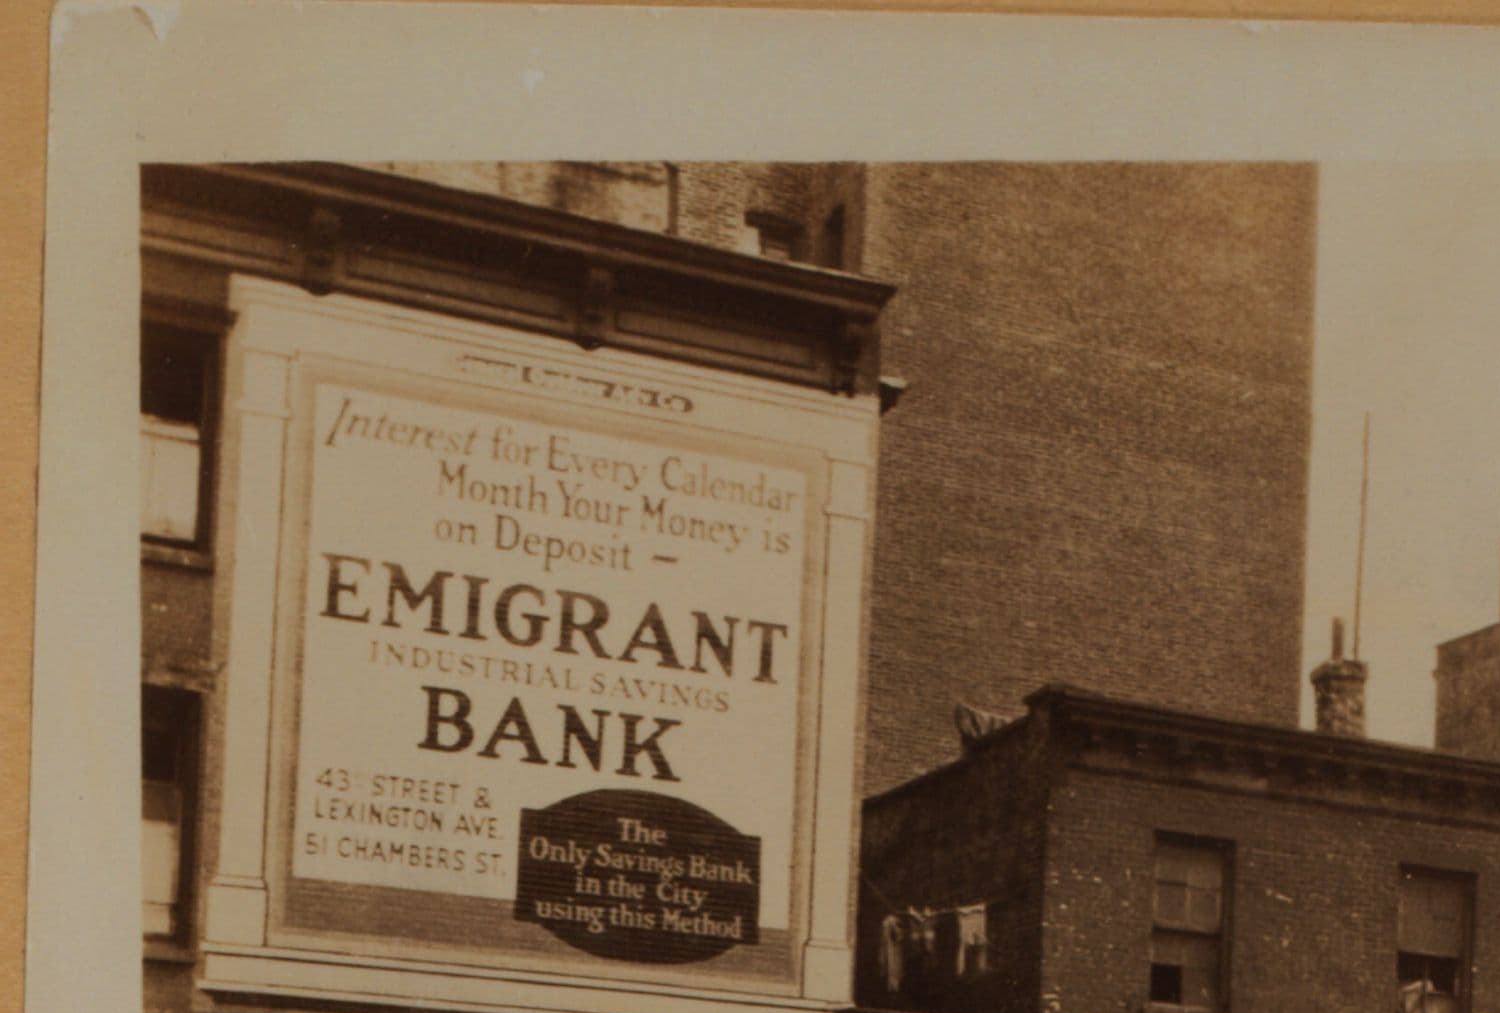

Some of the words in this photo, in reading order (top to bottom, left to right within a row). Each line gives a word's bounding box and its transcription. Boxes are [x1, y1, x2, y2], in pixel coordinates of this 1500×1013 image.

[325, 398, 478, 456] Interest
[491, 425, 540, 466] for
[548, 434, 646, 491] Every
[661, 455, 798, 512] Calendar
[436, 458, 549, 514] Month
[556, 479, 631, 526] Your
[639, 495, 749, 553] Money
[762, 517, 792, 554] is
[434, 518, 478, 545] on
[496, 513, 633, 572] Deposit
[319, 551, 789, 686] EMIGRANT
[368, 640, 580, 692] INDUSTRIAL
[590, 671, 730, 713] SAVINGS
[416, 684, 683, 783] BANK
[315, 767, 352, 792] 43
[371, 774, 462, 806] STREET
[473, 786, 492, 809] &
[313, 796, 443, 834] LEXINGTON
[617, 816, 667, 846] The
[304, 831, 330, 856] 51
[336, 835, 466, 873] CHAMBERS
[529, 835, 591, 870] Only
[595, 843, 684, 882] Savings
[688, 853, 753, 885] Bank
[575, 871, 601, 895] in
[608, 874, 646, 899] the
[656, 879, 709, 912] City
[535, 897, 604, 934] using
[609, 902, 656, 931] this
[661, 905, 744, 939] Method
